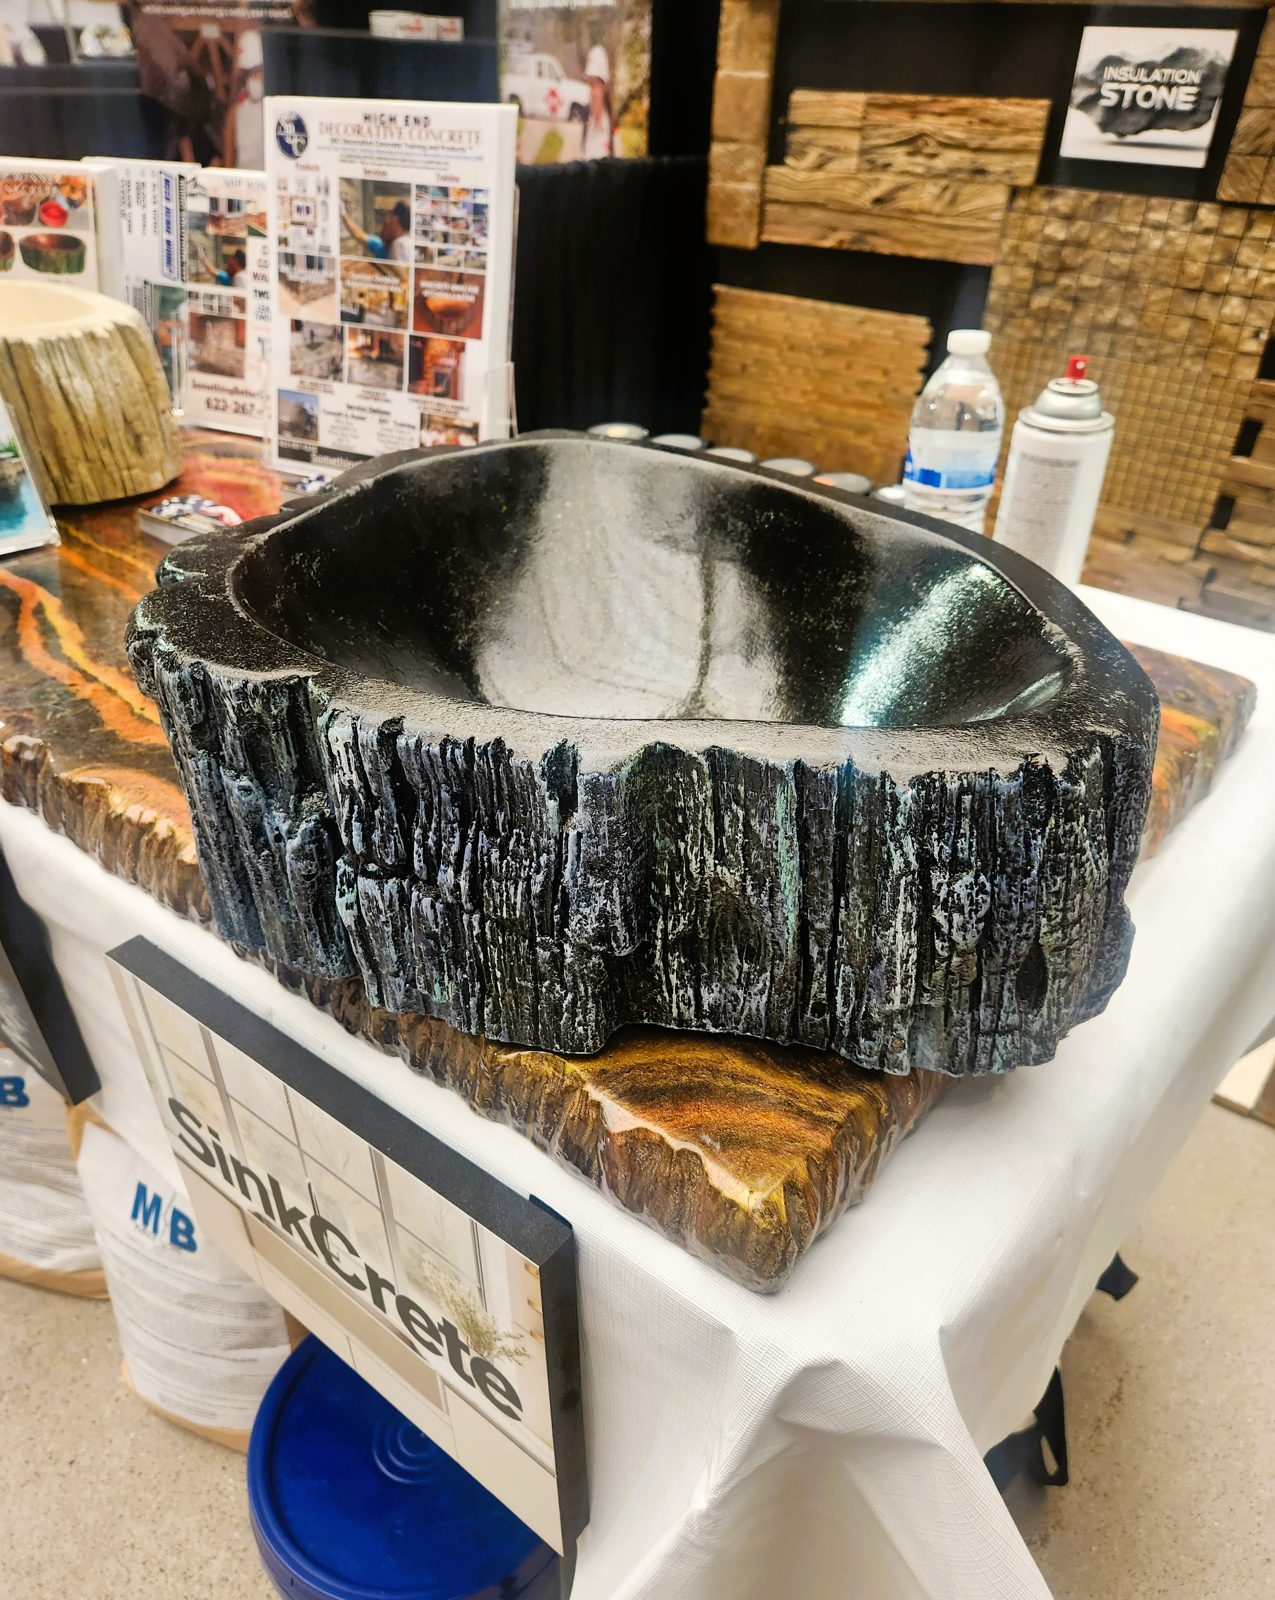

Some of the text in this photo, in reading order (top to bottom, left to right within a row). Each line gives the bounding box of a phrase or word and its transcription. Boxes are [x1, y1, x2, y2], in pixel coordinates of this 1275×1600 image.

[1103, 66, 1201, 84] INSULATION
[1099, 82, 1200, 111] STONE
[363, 112, 431, 128] HIGH END
[318, 121, 483, 145] DECORATIVE CONCRETE
[168, 1097, 524, 1422] SinkCrete
